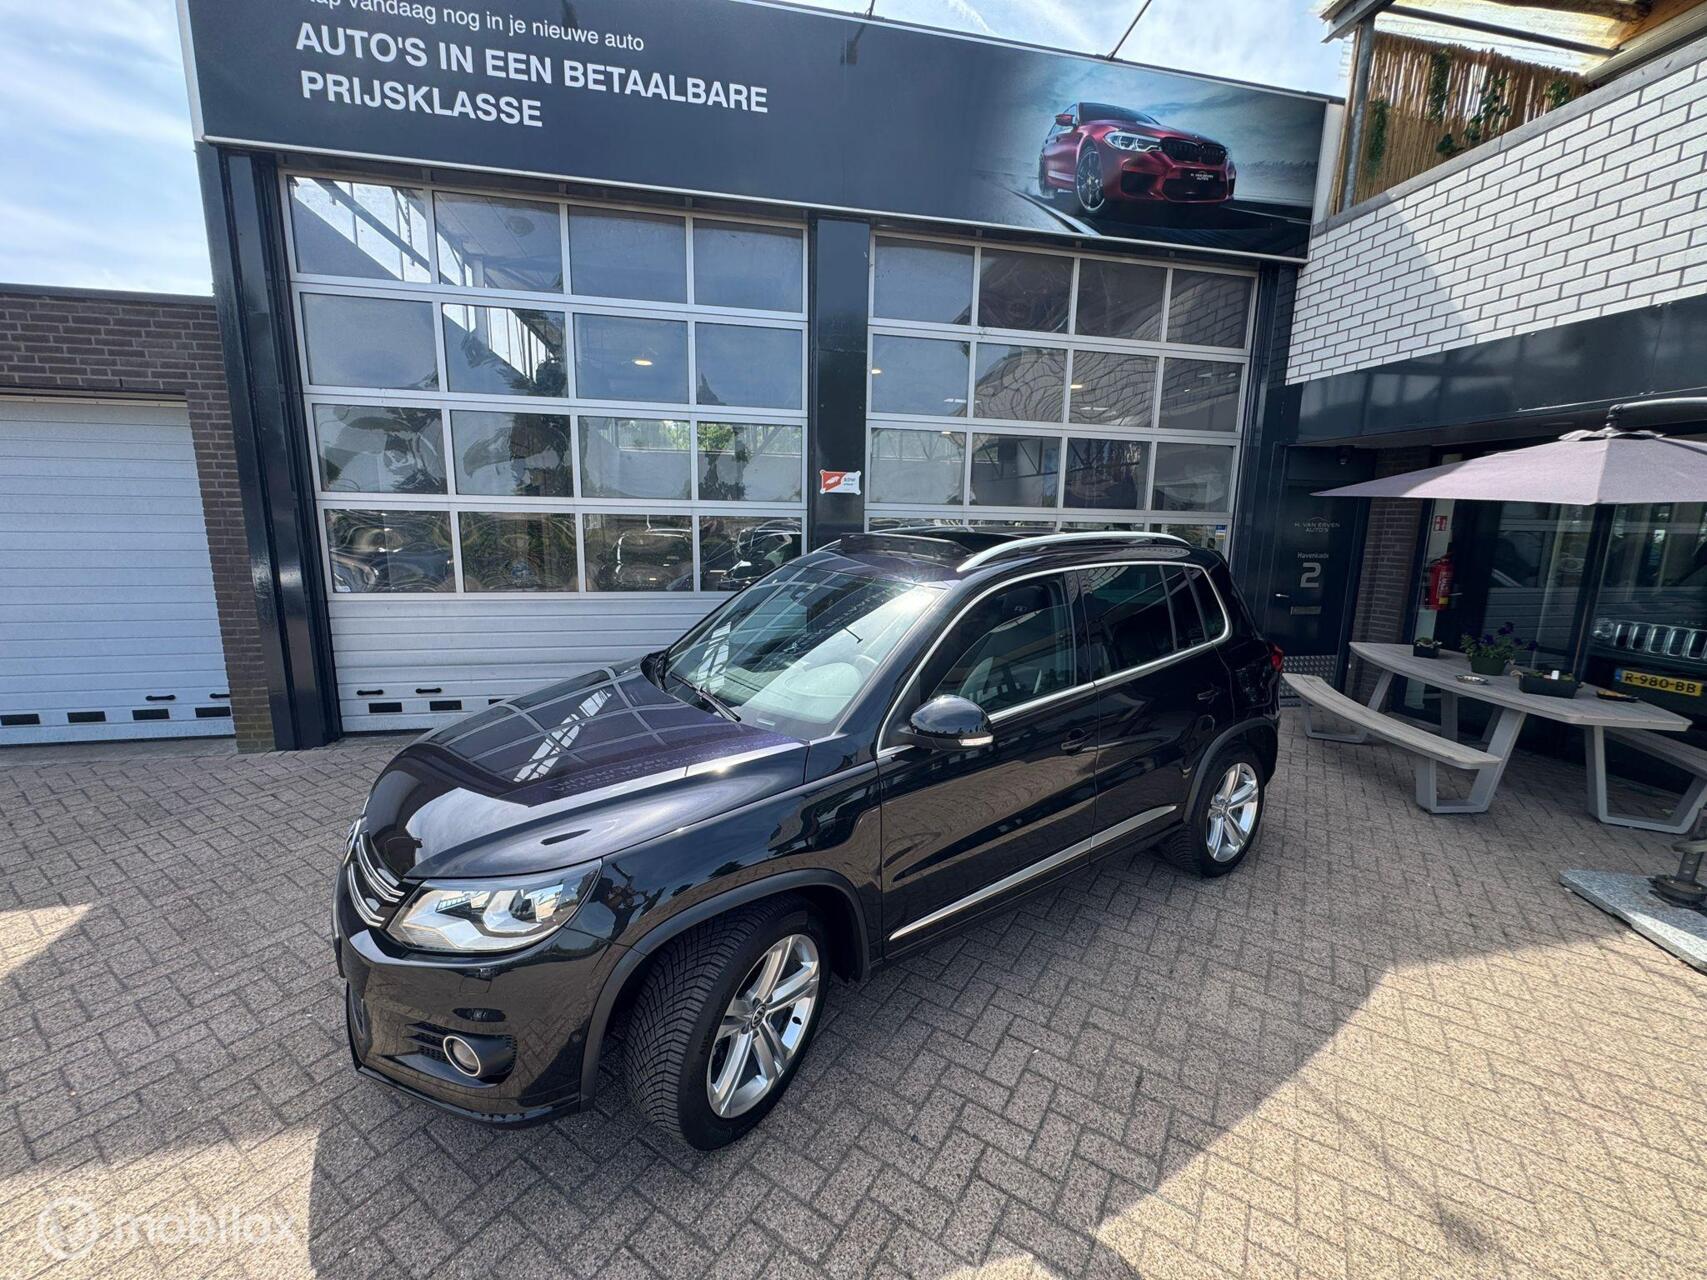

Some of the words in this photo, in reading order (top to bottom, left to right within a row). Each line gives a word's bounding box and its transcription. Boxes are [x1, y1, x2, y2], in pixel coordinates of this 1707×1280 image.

[349, 0, 437, 25] vandaag
[443, 8, 480, 31] nog
[486, 11, 503, 30] in
[508, 14, 526, 36] je
[532, 19, 599, 44] nieuwe
[604, 32, 645, 51] auto
[295, 21, 429, 67] AUTO'S
[438, 41, 474, 73] IN
[485, 48, 552, 84] EEN
[563, 59, 769, 113] BETAALBARE
[300, 70, 543, 127] PRIJSKLASSE
[1300, 562, 1321, 588] 2
[1624, 672, 1697, 694] R-980-BB
